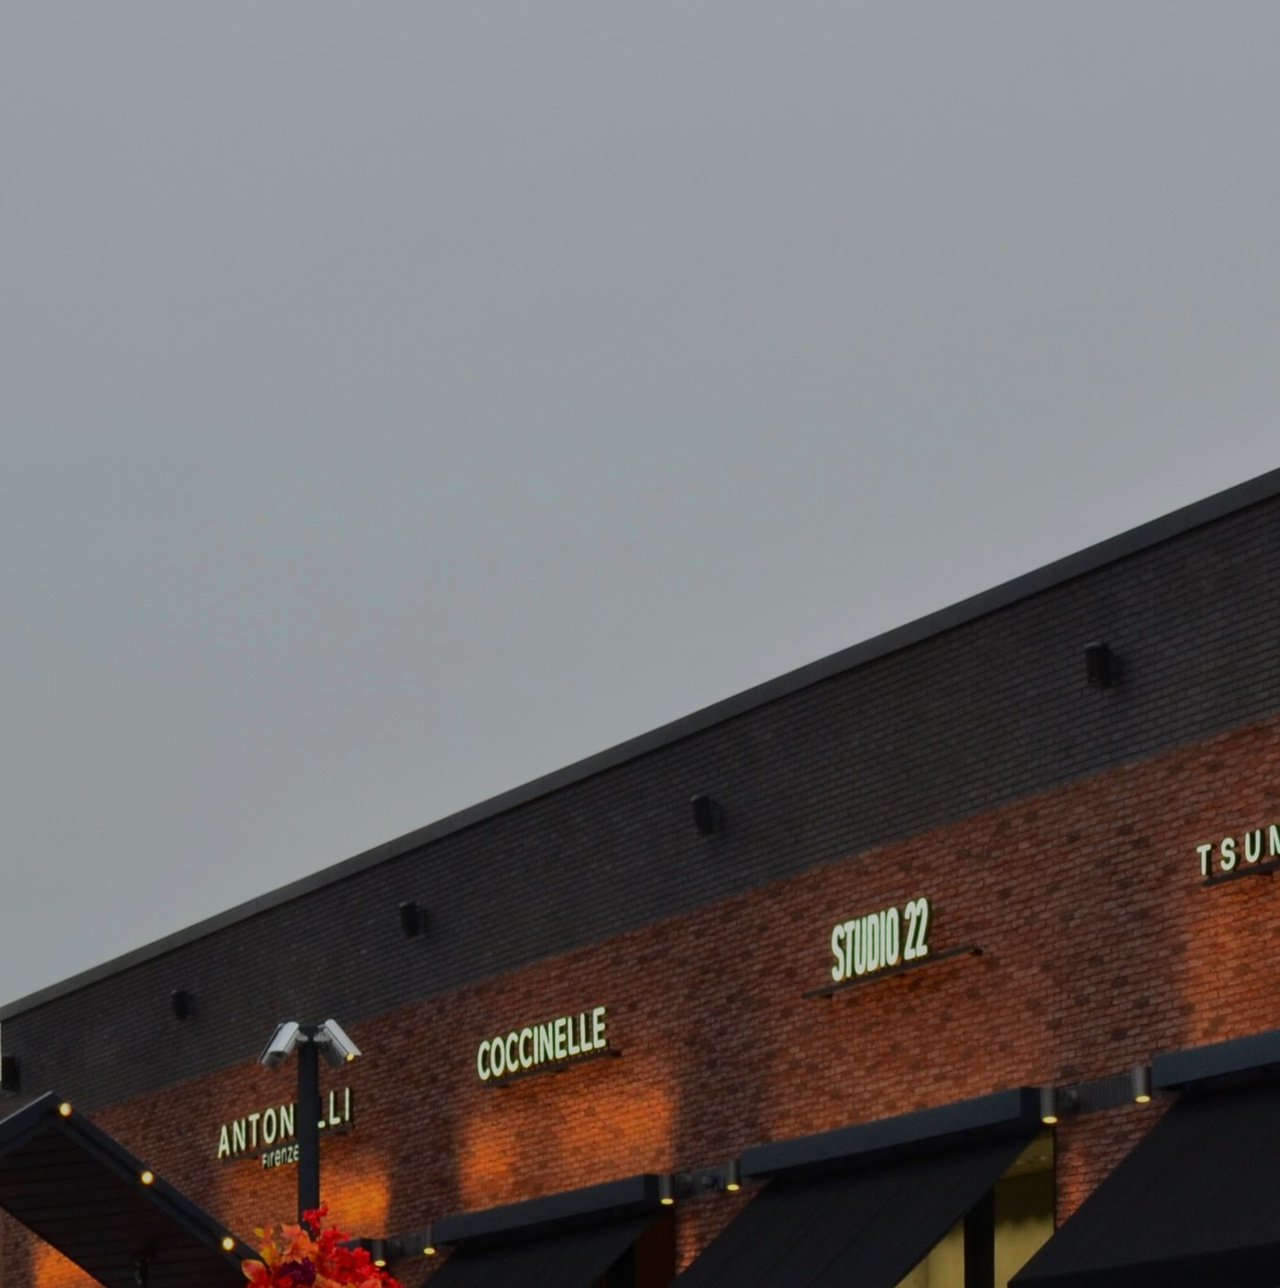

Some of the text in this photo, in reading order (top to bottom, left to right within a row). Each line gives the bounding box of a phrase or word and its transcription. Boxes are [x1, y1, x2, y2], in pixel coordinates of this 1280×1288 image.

[831, 897, 929, 982] STUDIO 22
[476, 1005, 607, 1081] COCCINELLE
[217, 1086, 351, 1160] ANTONLI
